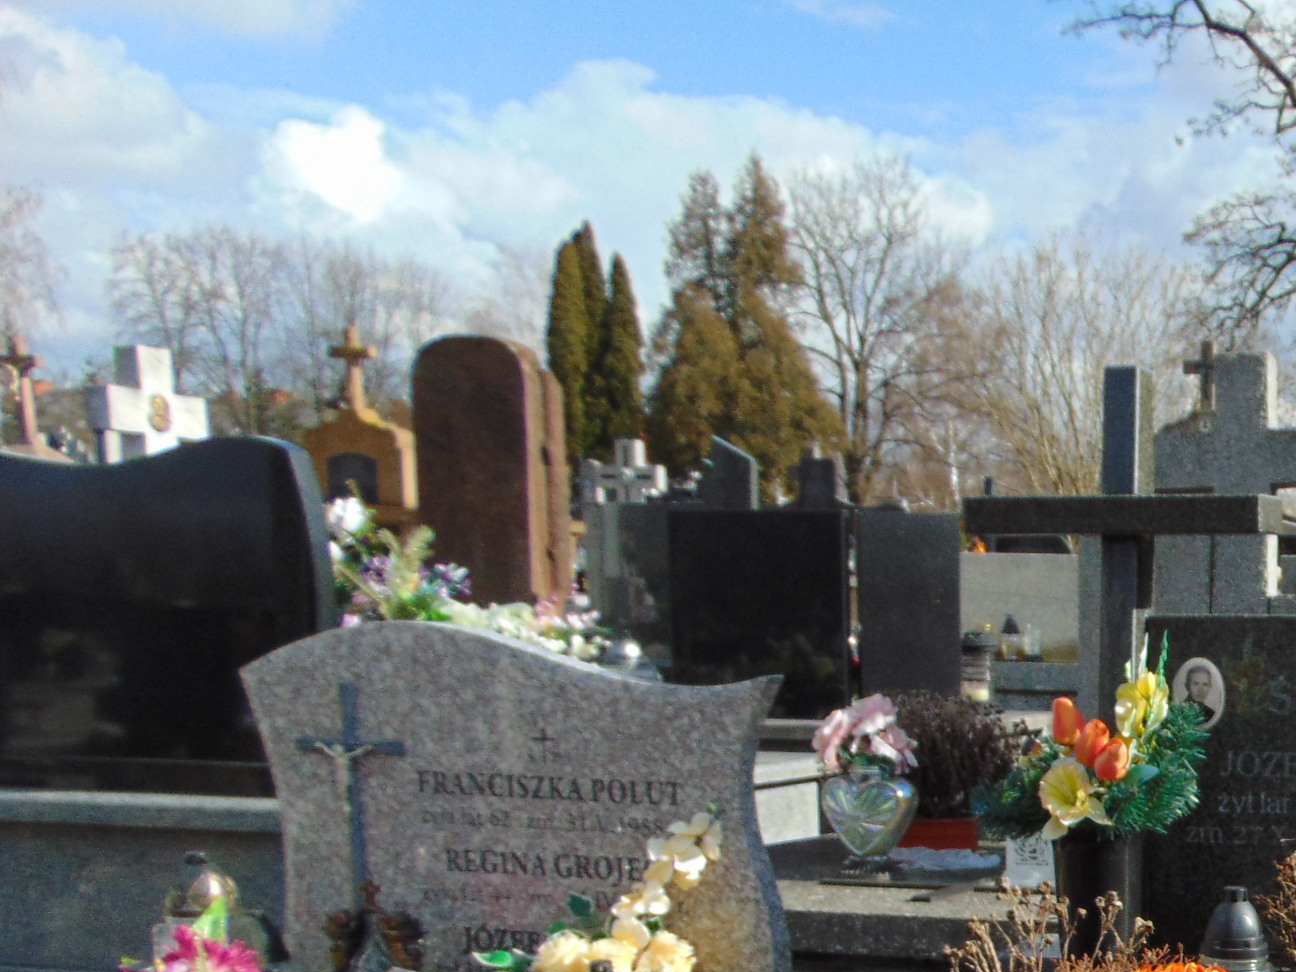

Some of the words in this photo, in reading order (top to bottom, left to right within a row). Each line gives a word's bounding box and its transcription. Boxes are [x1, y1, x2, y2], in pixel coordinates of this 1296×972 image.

[416, 770, 584, 802] FRANCISZKA
[445, 848, 548, 877] REGINA
[553, 853, 650, 884] GROJE
